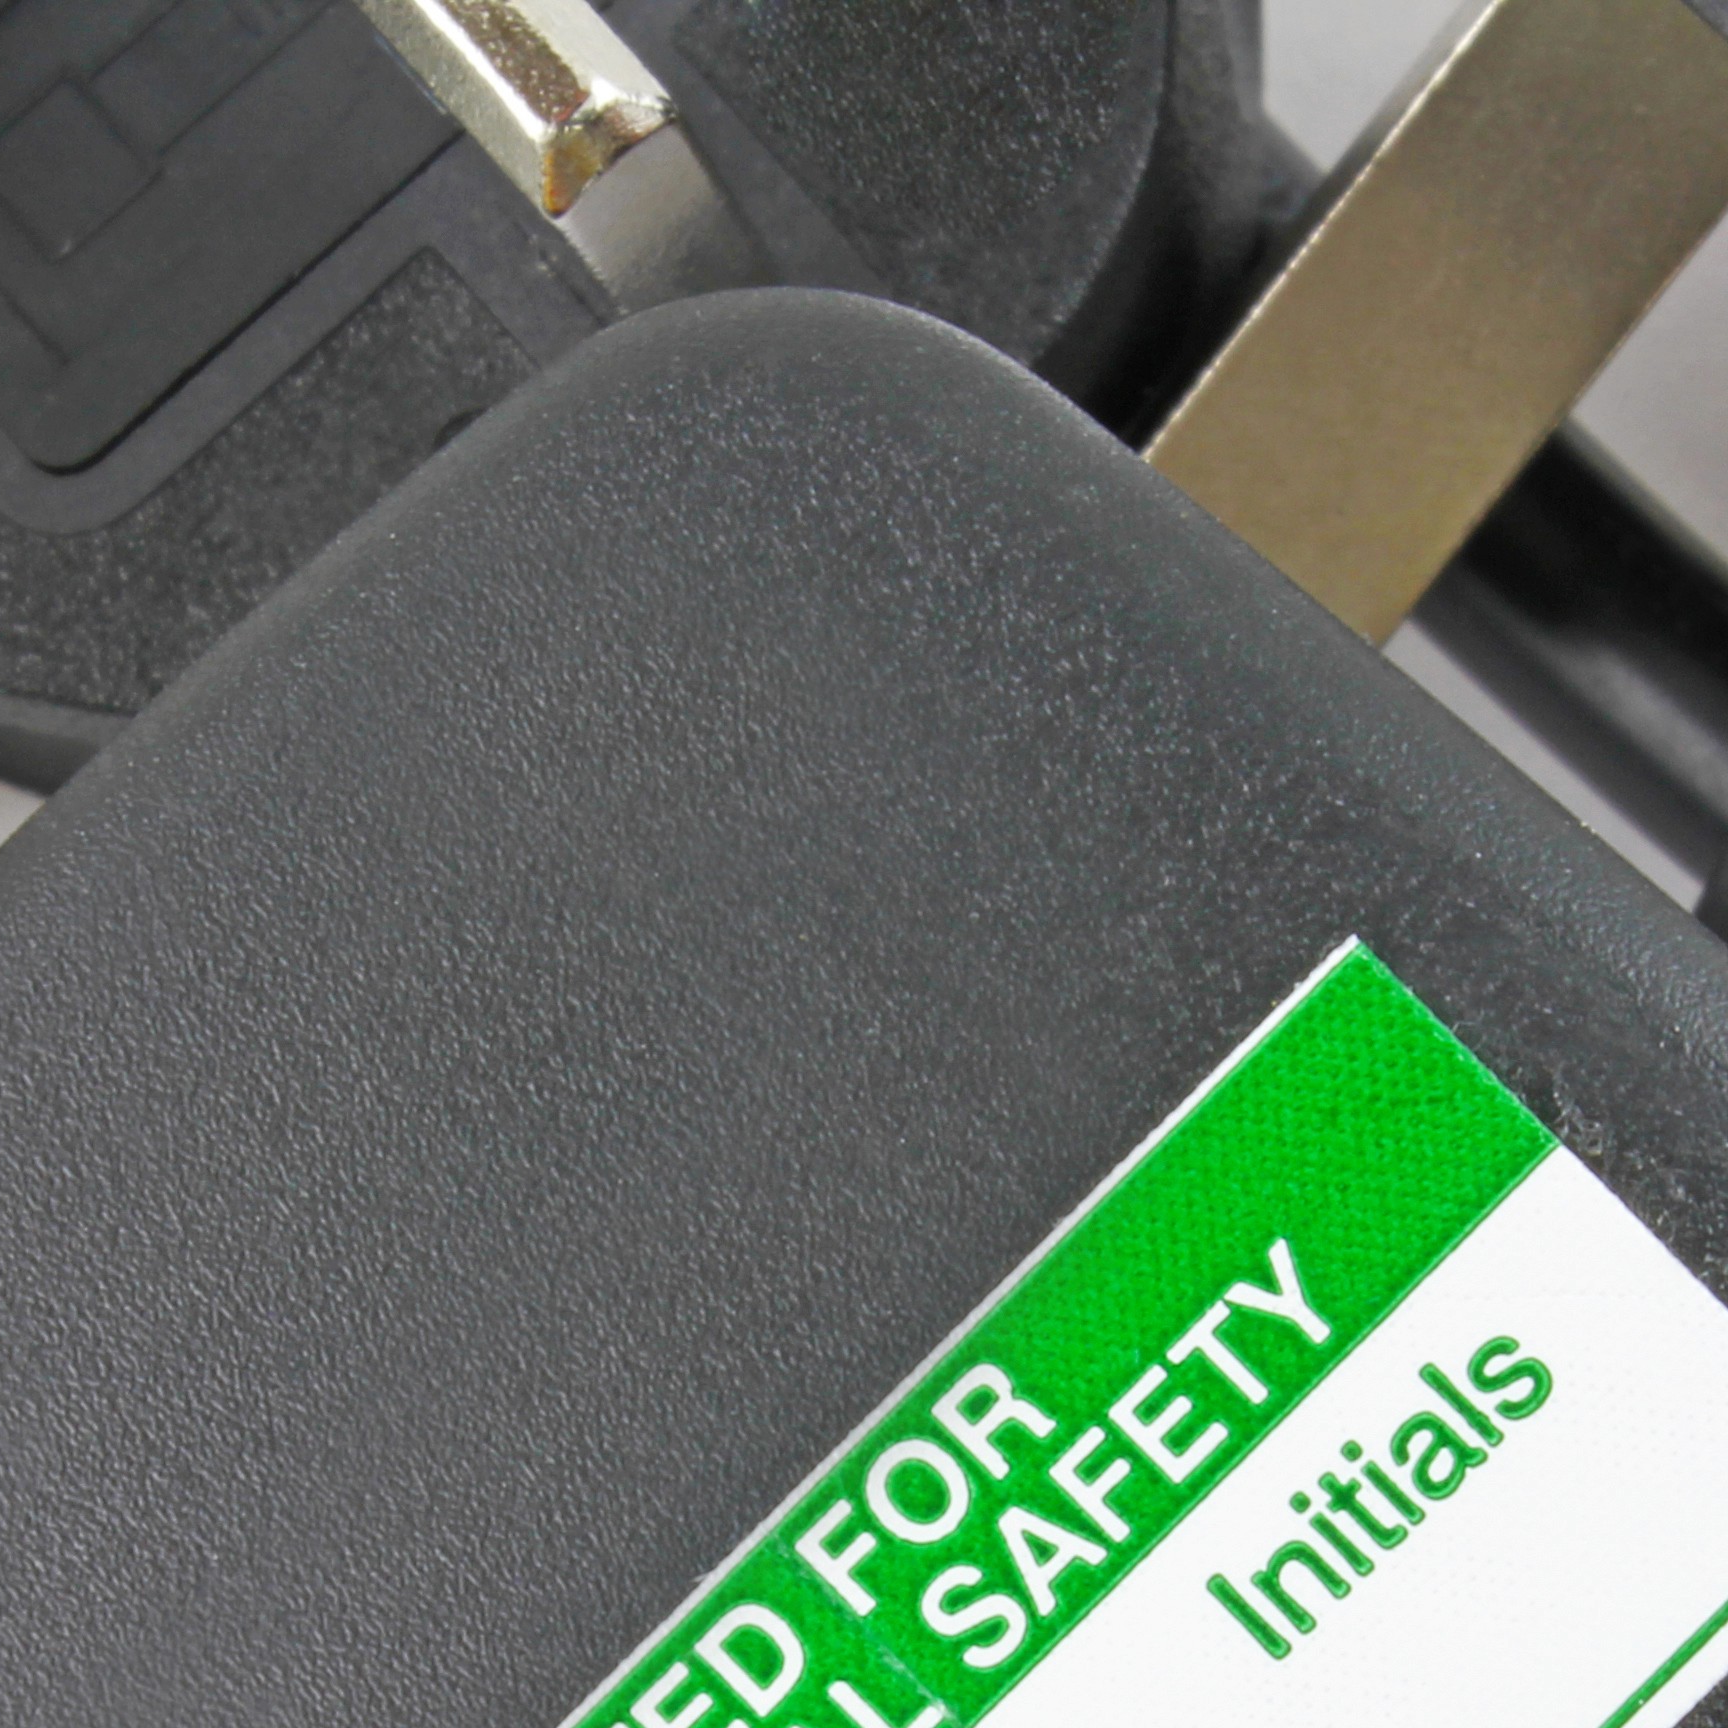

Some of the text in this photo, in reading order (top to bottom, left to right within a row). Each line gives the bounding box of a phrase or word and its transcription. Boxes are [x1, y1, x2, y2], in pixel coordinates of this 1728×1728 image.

[795, 1364, 1056, 1616] FOR
[922, 1239, 1330, 1667] SAFETY
[1207, 1335, 1553, 1661] Initials
